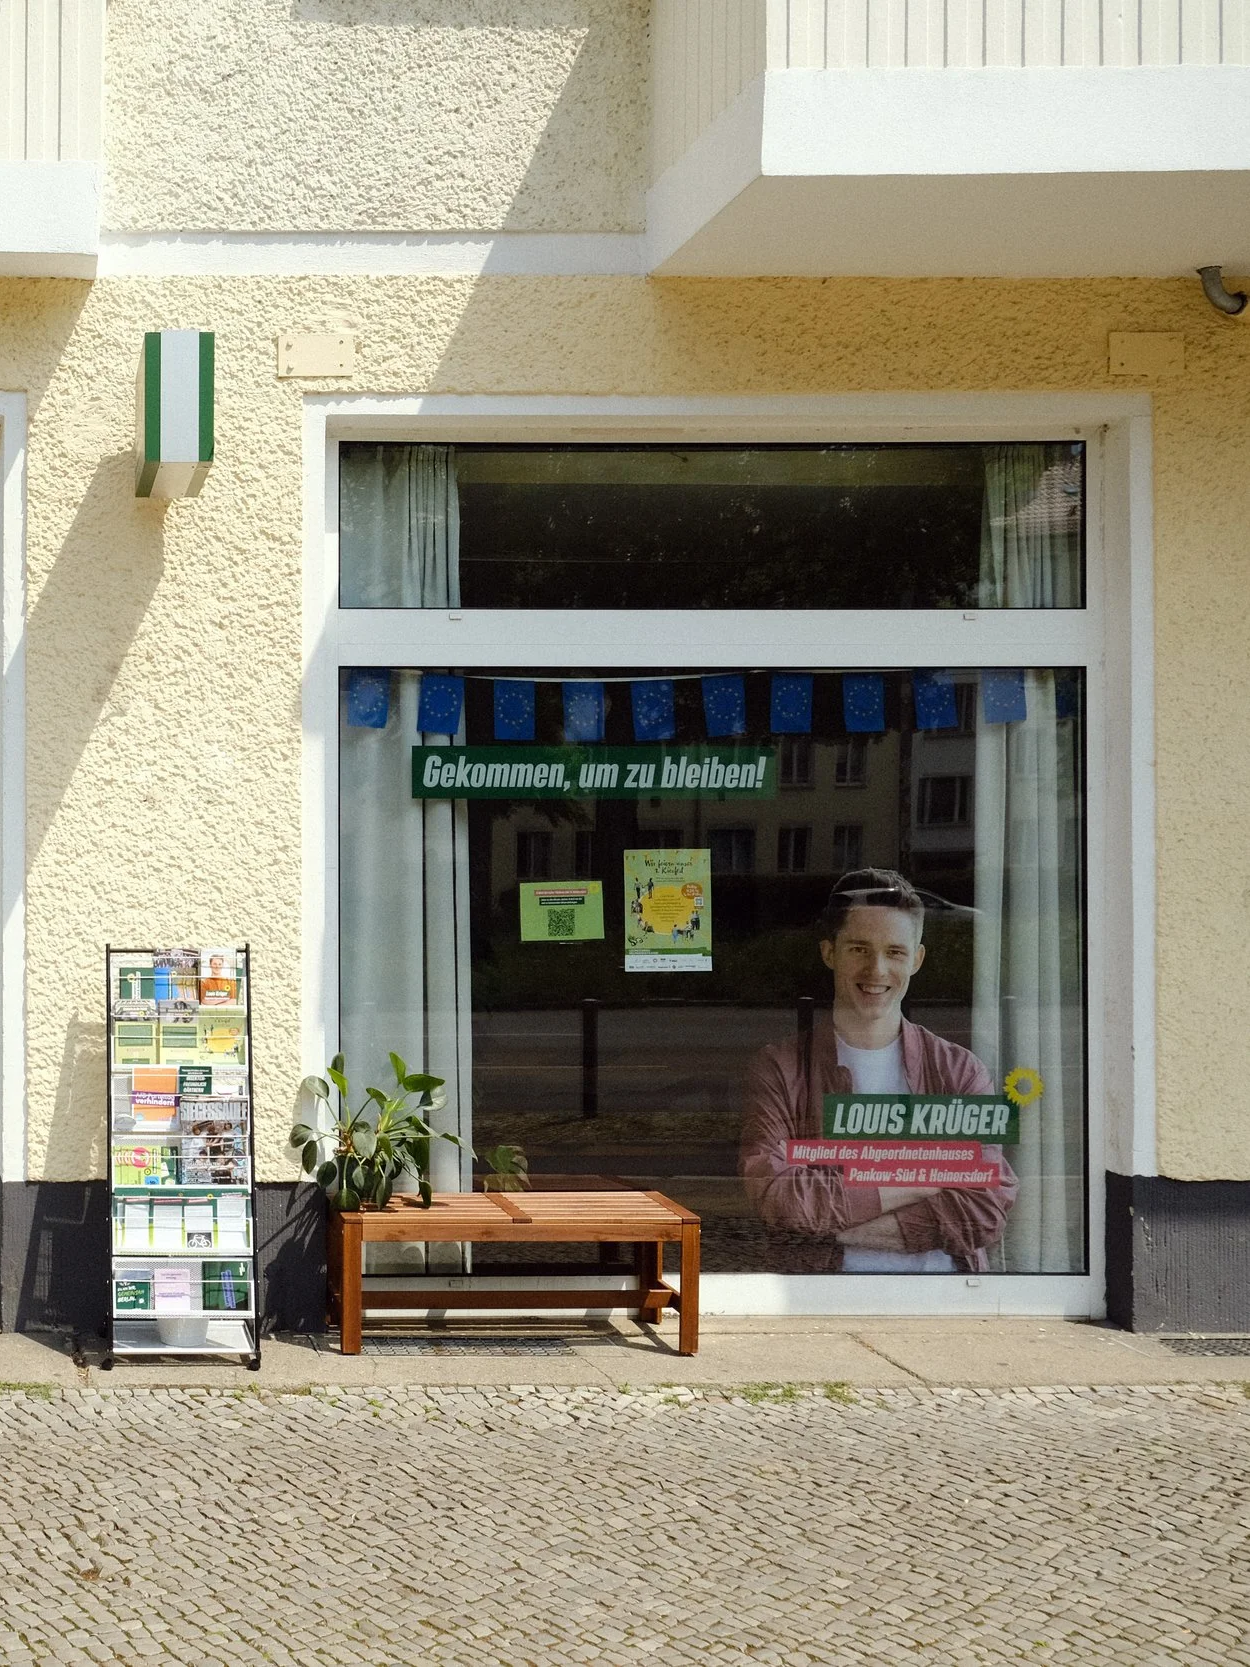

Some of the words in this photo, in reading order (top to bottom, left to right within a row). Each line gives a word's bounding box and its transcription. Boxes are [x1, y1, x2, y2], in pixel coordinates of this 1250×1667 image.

[422, 754, 572, 792] Gekommen,
[578, 762, 618, 789] um
[623, 762, 659, 789] zu
[660, 755, 767, 789] bleiben!
[832, 1103, 907, 1135] LOUIS
[910, 1098, 1010, 1135] KRÜGER
[792, 1145, 838, 1163] Mitglied
[838, 1145, 859, 1160] des
[860, 1145, 975, 1163] Abgeordnetenhauses
[848, 1167, 916, 1182] Pankow-Süd
[917, 1168, 927, 1182] &
[928, 1168, 994, 1184] Heinersdorf
